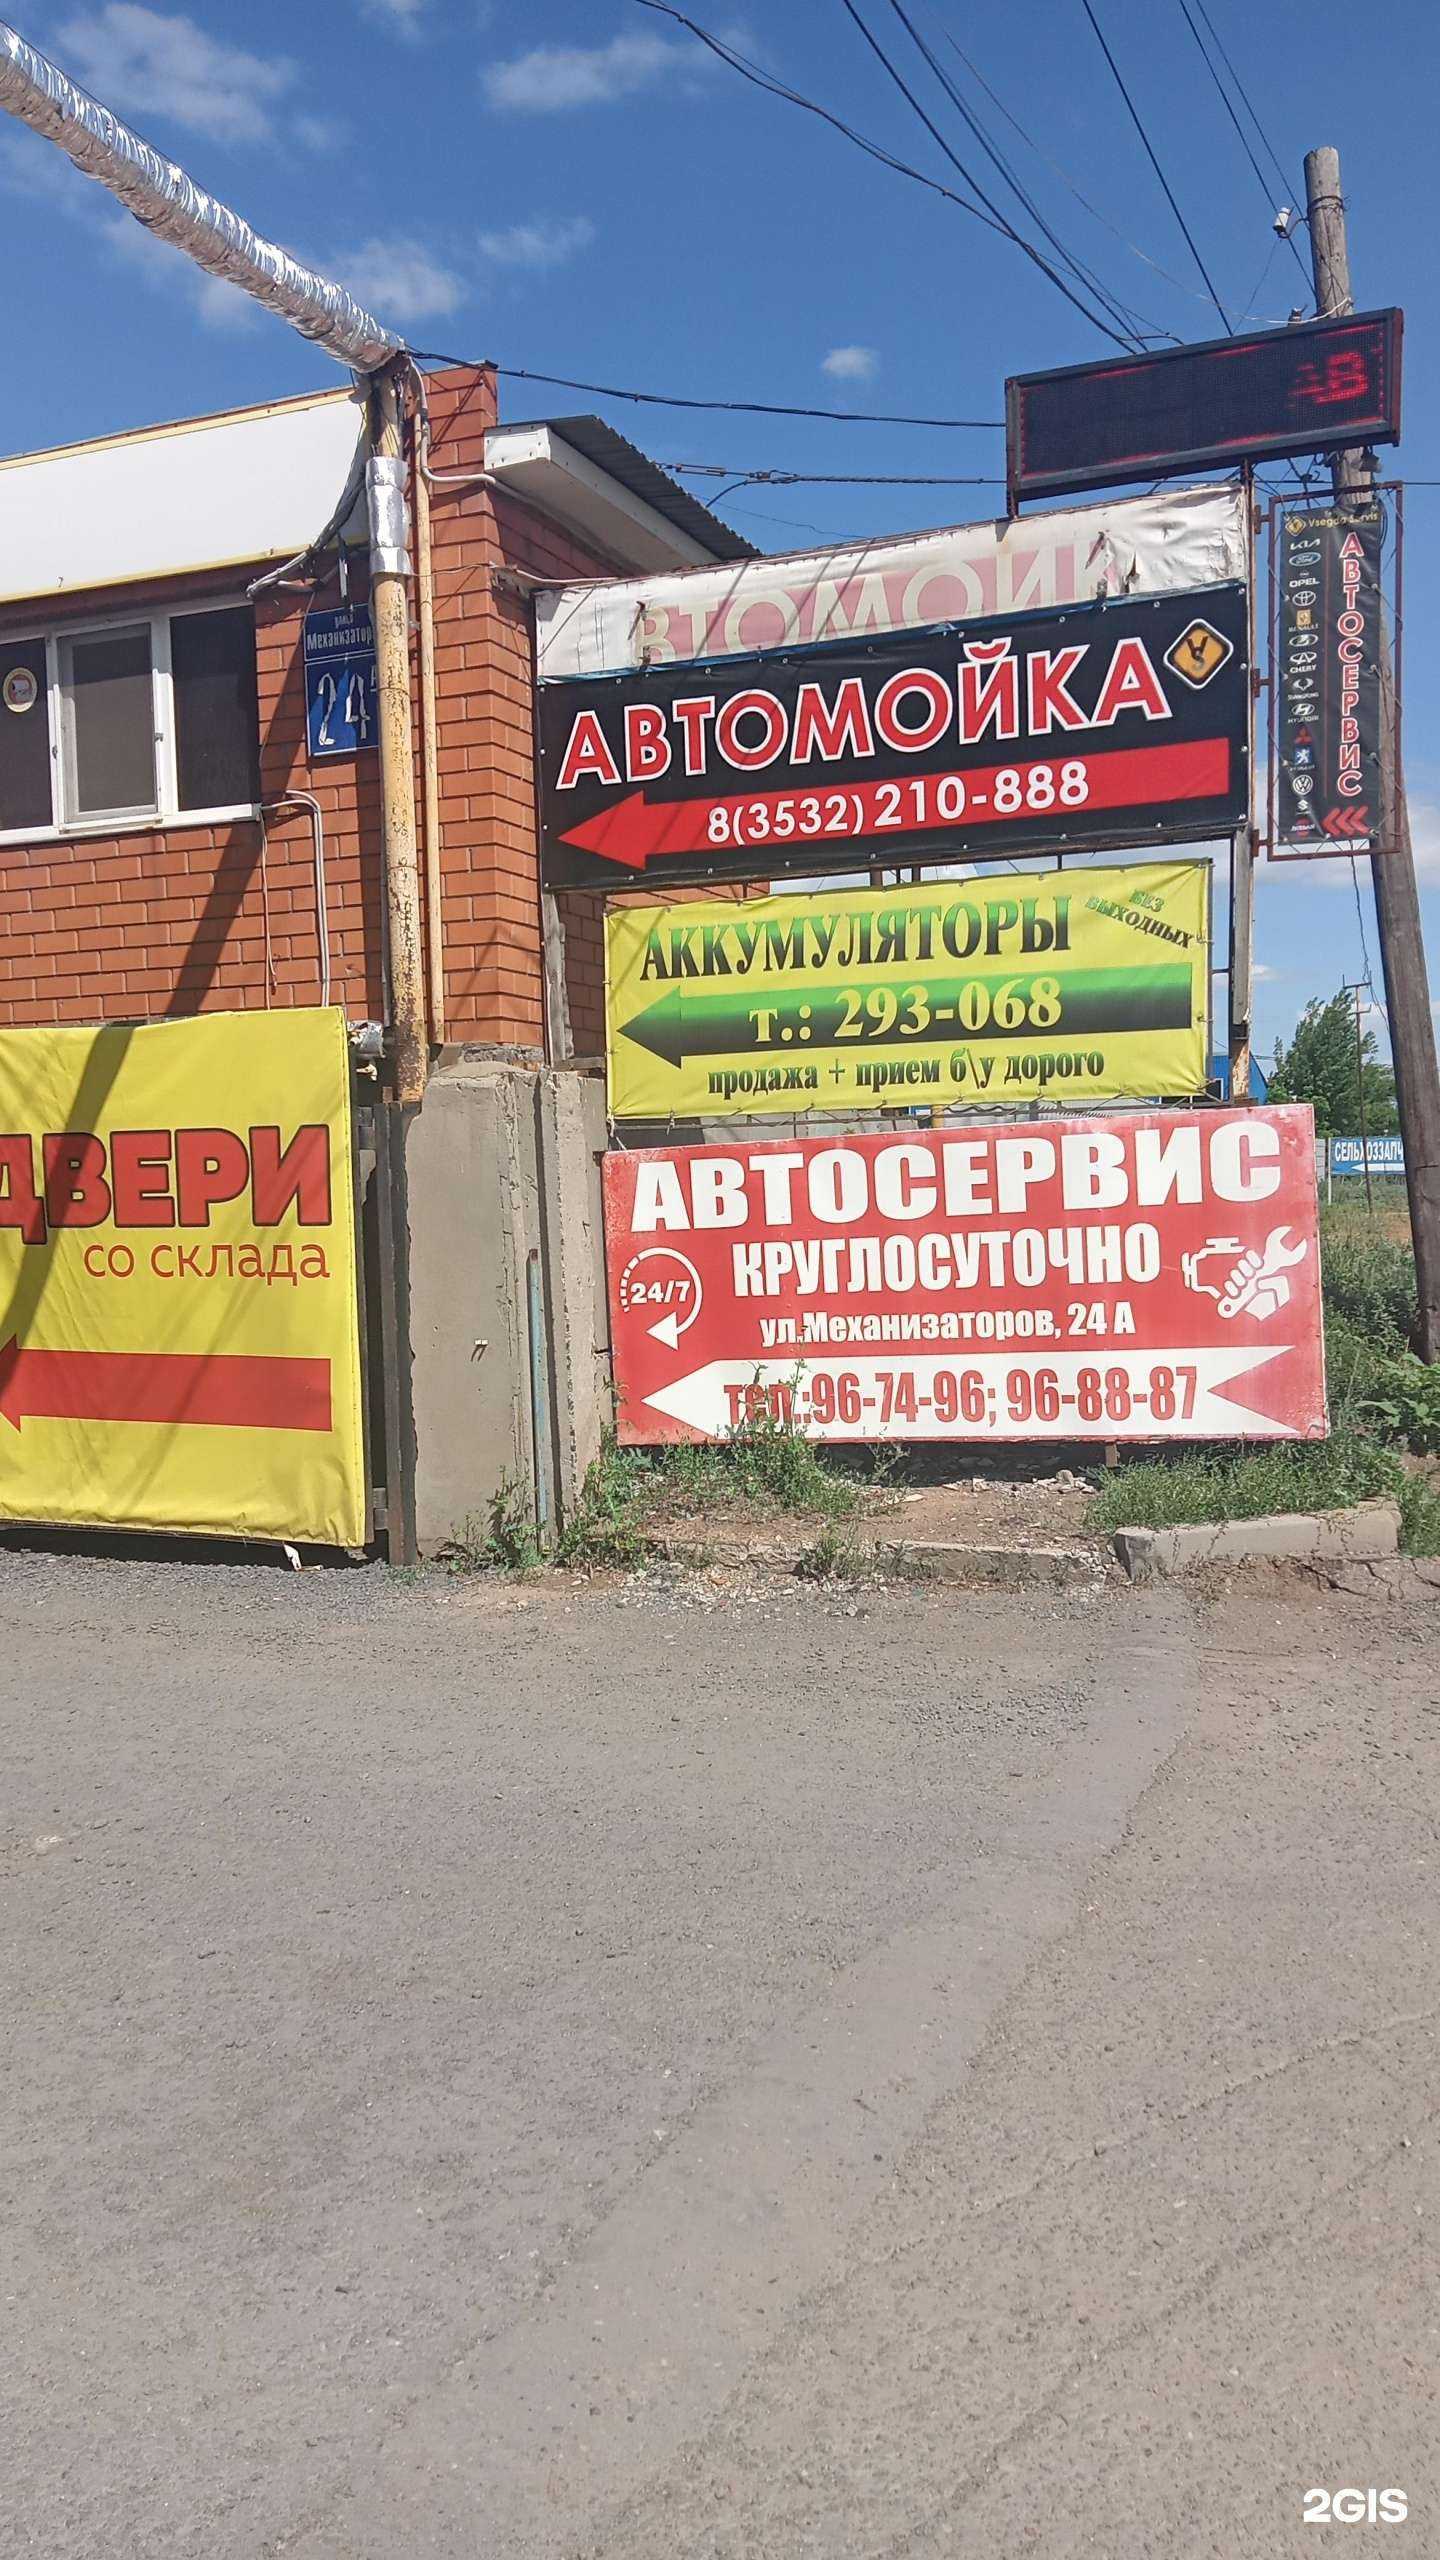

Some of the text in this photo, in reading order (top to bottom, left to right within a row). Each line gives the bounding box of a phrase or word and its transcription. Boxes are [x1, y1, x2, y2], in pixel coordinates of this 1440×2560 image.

[307, 625, 372, 651] Механизатор
[1337, 532, 1364, 797] АВТОСЕРВИС
[317, 672, 371, 746] 24
[556, 636, 1172, 790] АВТОМОЙКА
[708, 761, 1089, 845] 8(3532) 210-888
[640, 894, 1071, 981] АККУМУЛЯТОРЫ
[835, 976, 1062, 1039] 293-068
[708, 1057, 819, 1099] продажа
[856, 1055, 940, 1094] прием
[950, 1047, 993, 1091] б\у
[1004, 1048, 1104, 1085] дорого
[0, 1124, 332, 1245] ДВЕРИ
[631, 1120, 1282, 1233] АВТОСЕРВИС
[1334, 1141, 1404, 1162] СЕЛЬХОЗЗАПЧ
[84, 1243, 330, 1286] со склада
[630, 1280, 691, 1303] 24/7
[732, 1222, 1160, 1297] КРУГЛОСУТОЧНО
[1068, 1302, 1107, 1335] 24
[1007, 1366, 1198, 1423] 96-88-87
